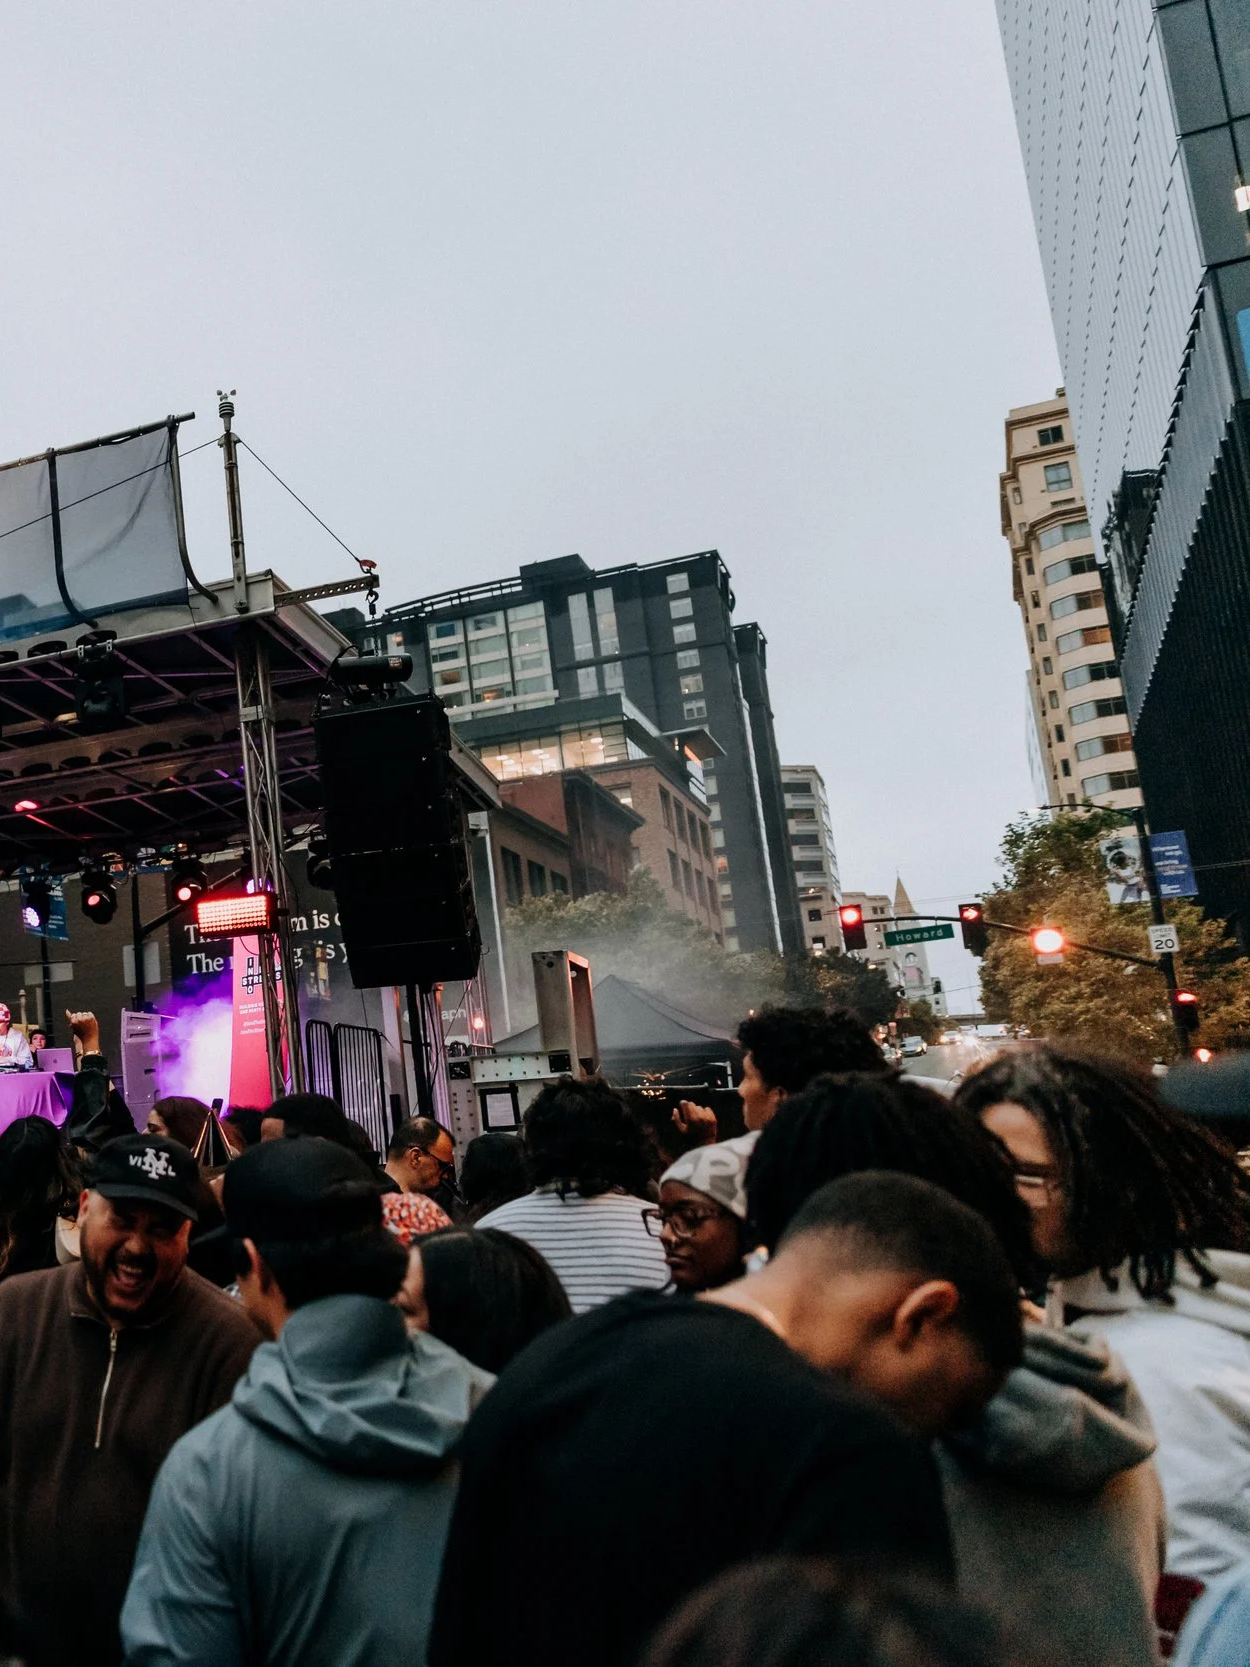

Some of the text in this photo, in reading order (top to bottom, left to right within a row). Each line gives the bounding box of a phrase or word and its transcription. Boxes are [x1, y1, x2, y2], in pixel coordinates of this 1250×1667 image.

[312, 909, 330, 930] is
[895, 928, 944, 943] Howard
[1154, 938, 1175, 950] 20
[186, 953, 225, 974] The
[242, 971, 281, 988] STRS
